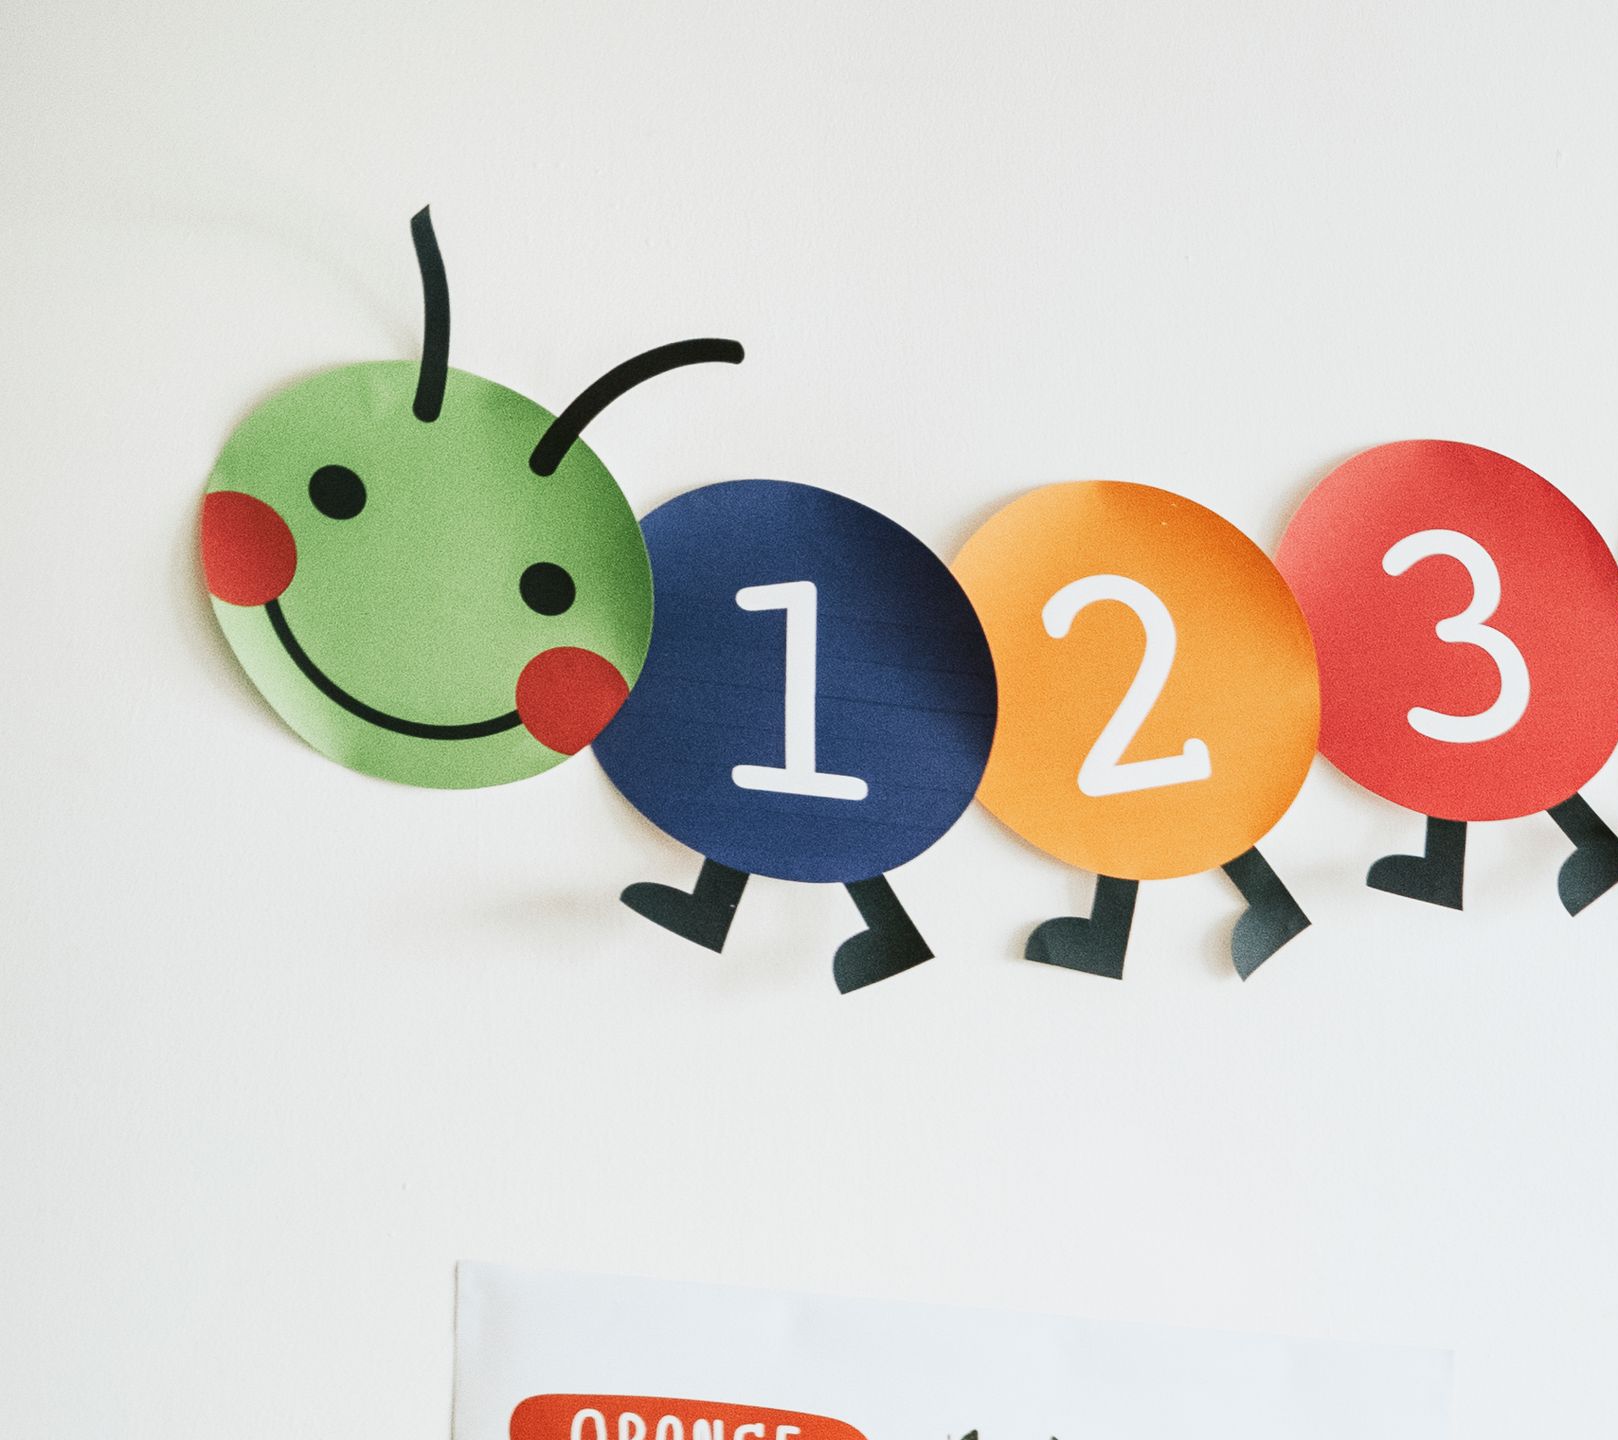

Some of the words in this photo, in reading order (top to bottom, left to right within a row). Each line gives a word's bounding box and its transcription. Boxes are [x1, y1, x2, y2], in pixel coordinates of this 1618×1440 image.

[731, 579, 868, 801] 1
[1041, 573, 1213, 798] 2
[1381, 529, 1531, 743] 3
